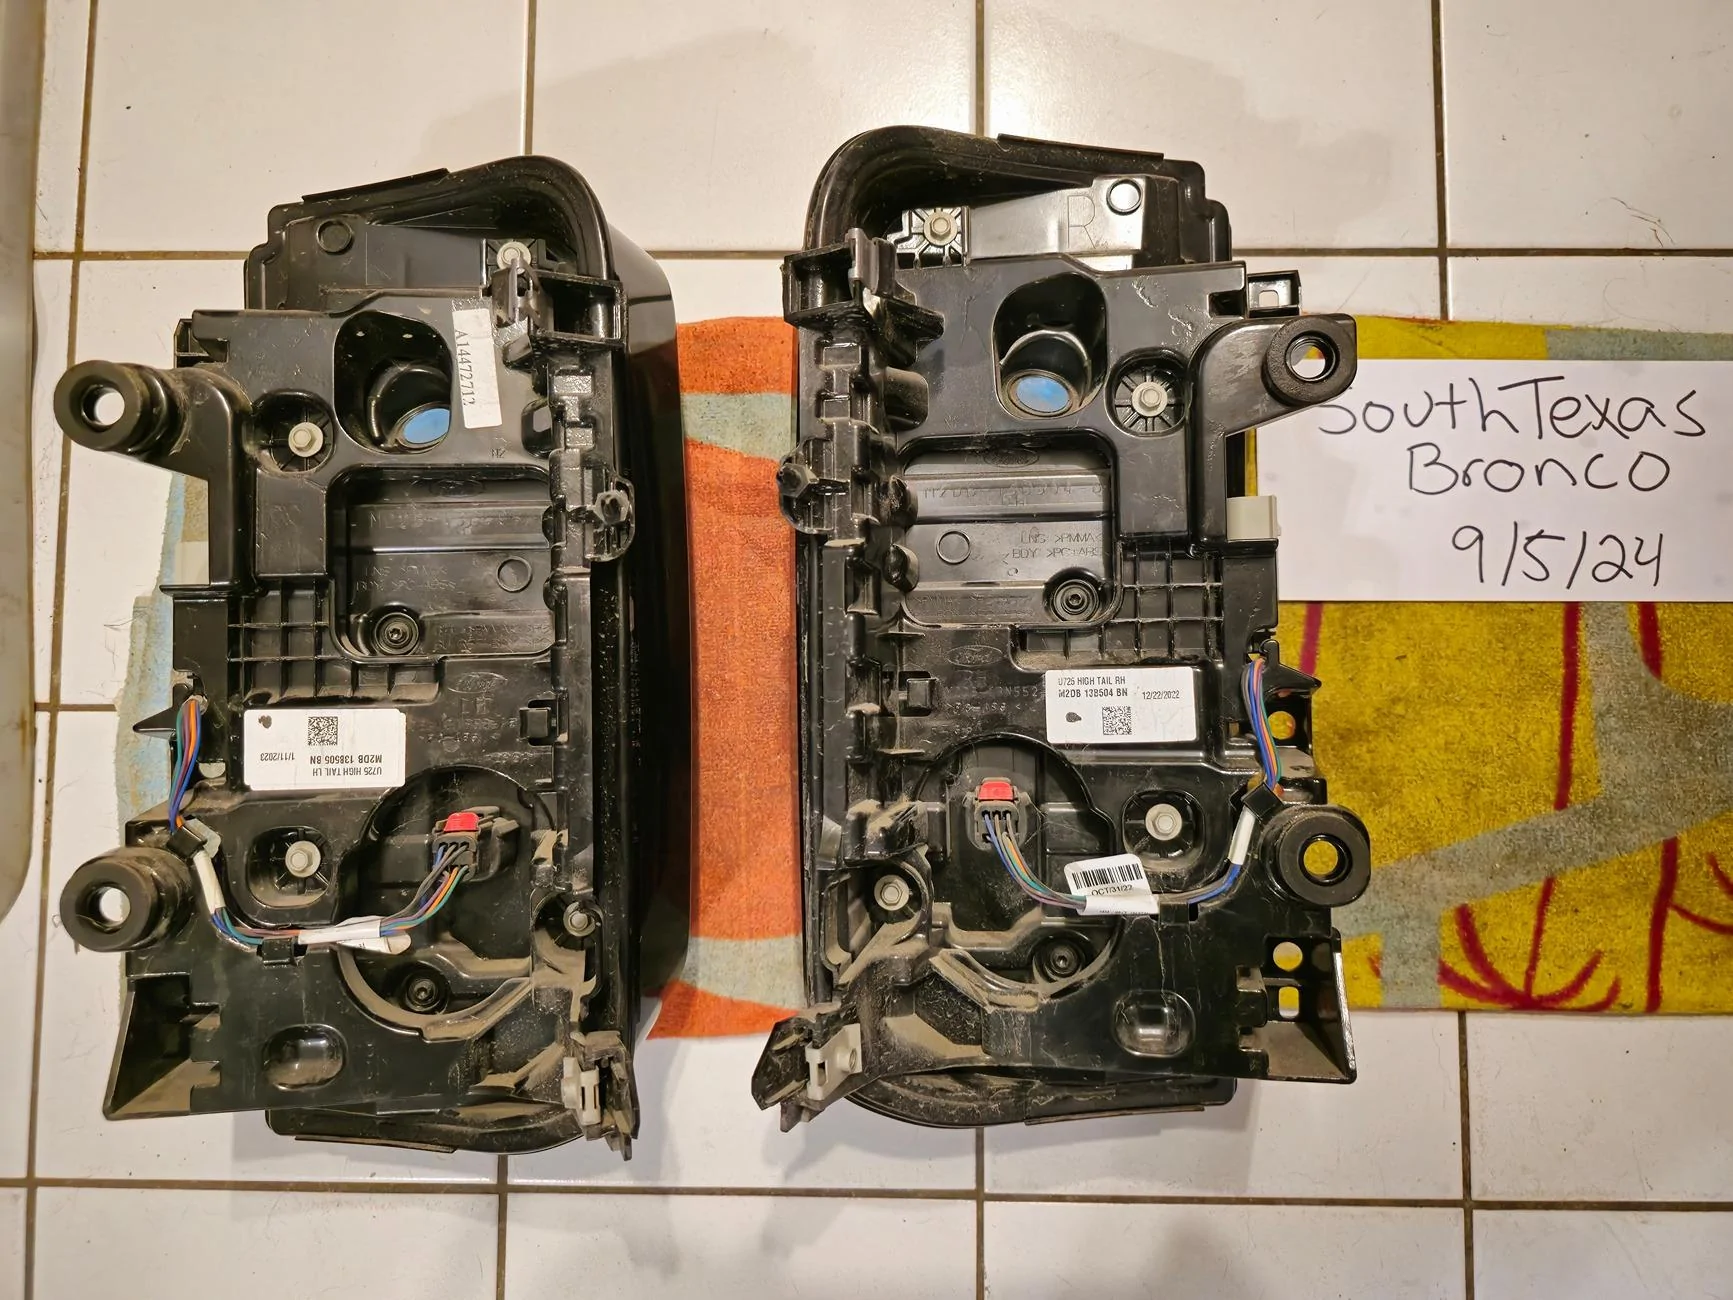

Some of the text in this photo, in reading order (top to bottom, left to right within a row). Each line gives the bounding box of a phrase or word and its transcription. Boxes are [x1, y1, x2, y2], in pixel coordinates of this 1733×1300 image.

[1498, 375, 1705, 439] Texas
[1407, 442, 1670, 495] Bronco
[1452, 521, 1664, 591] 9/5/24
[1077, 676, 1095, 686] HIGH
[1097, 676, 1113, 685] TAIL
[1115, 675, 1126, 685] RH
[1058, 688, 1082, 698] M2DB
[1116, 687, 1128, 697] BN
[1142, 690, 1180, 700] 12/22/2022
[260, 752, 295, 761] 1/11/2023
[310, 755, 322, 765] BN
[357, 754, 382, 764] M2DB
[312, 766, 382, 777] U725 HIGH TAIL LH
[1091, 884, 1133, 896] OCT/31/22
